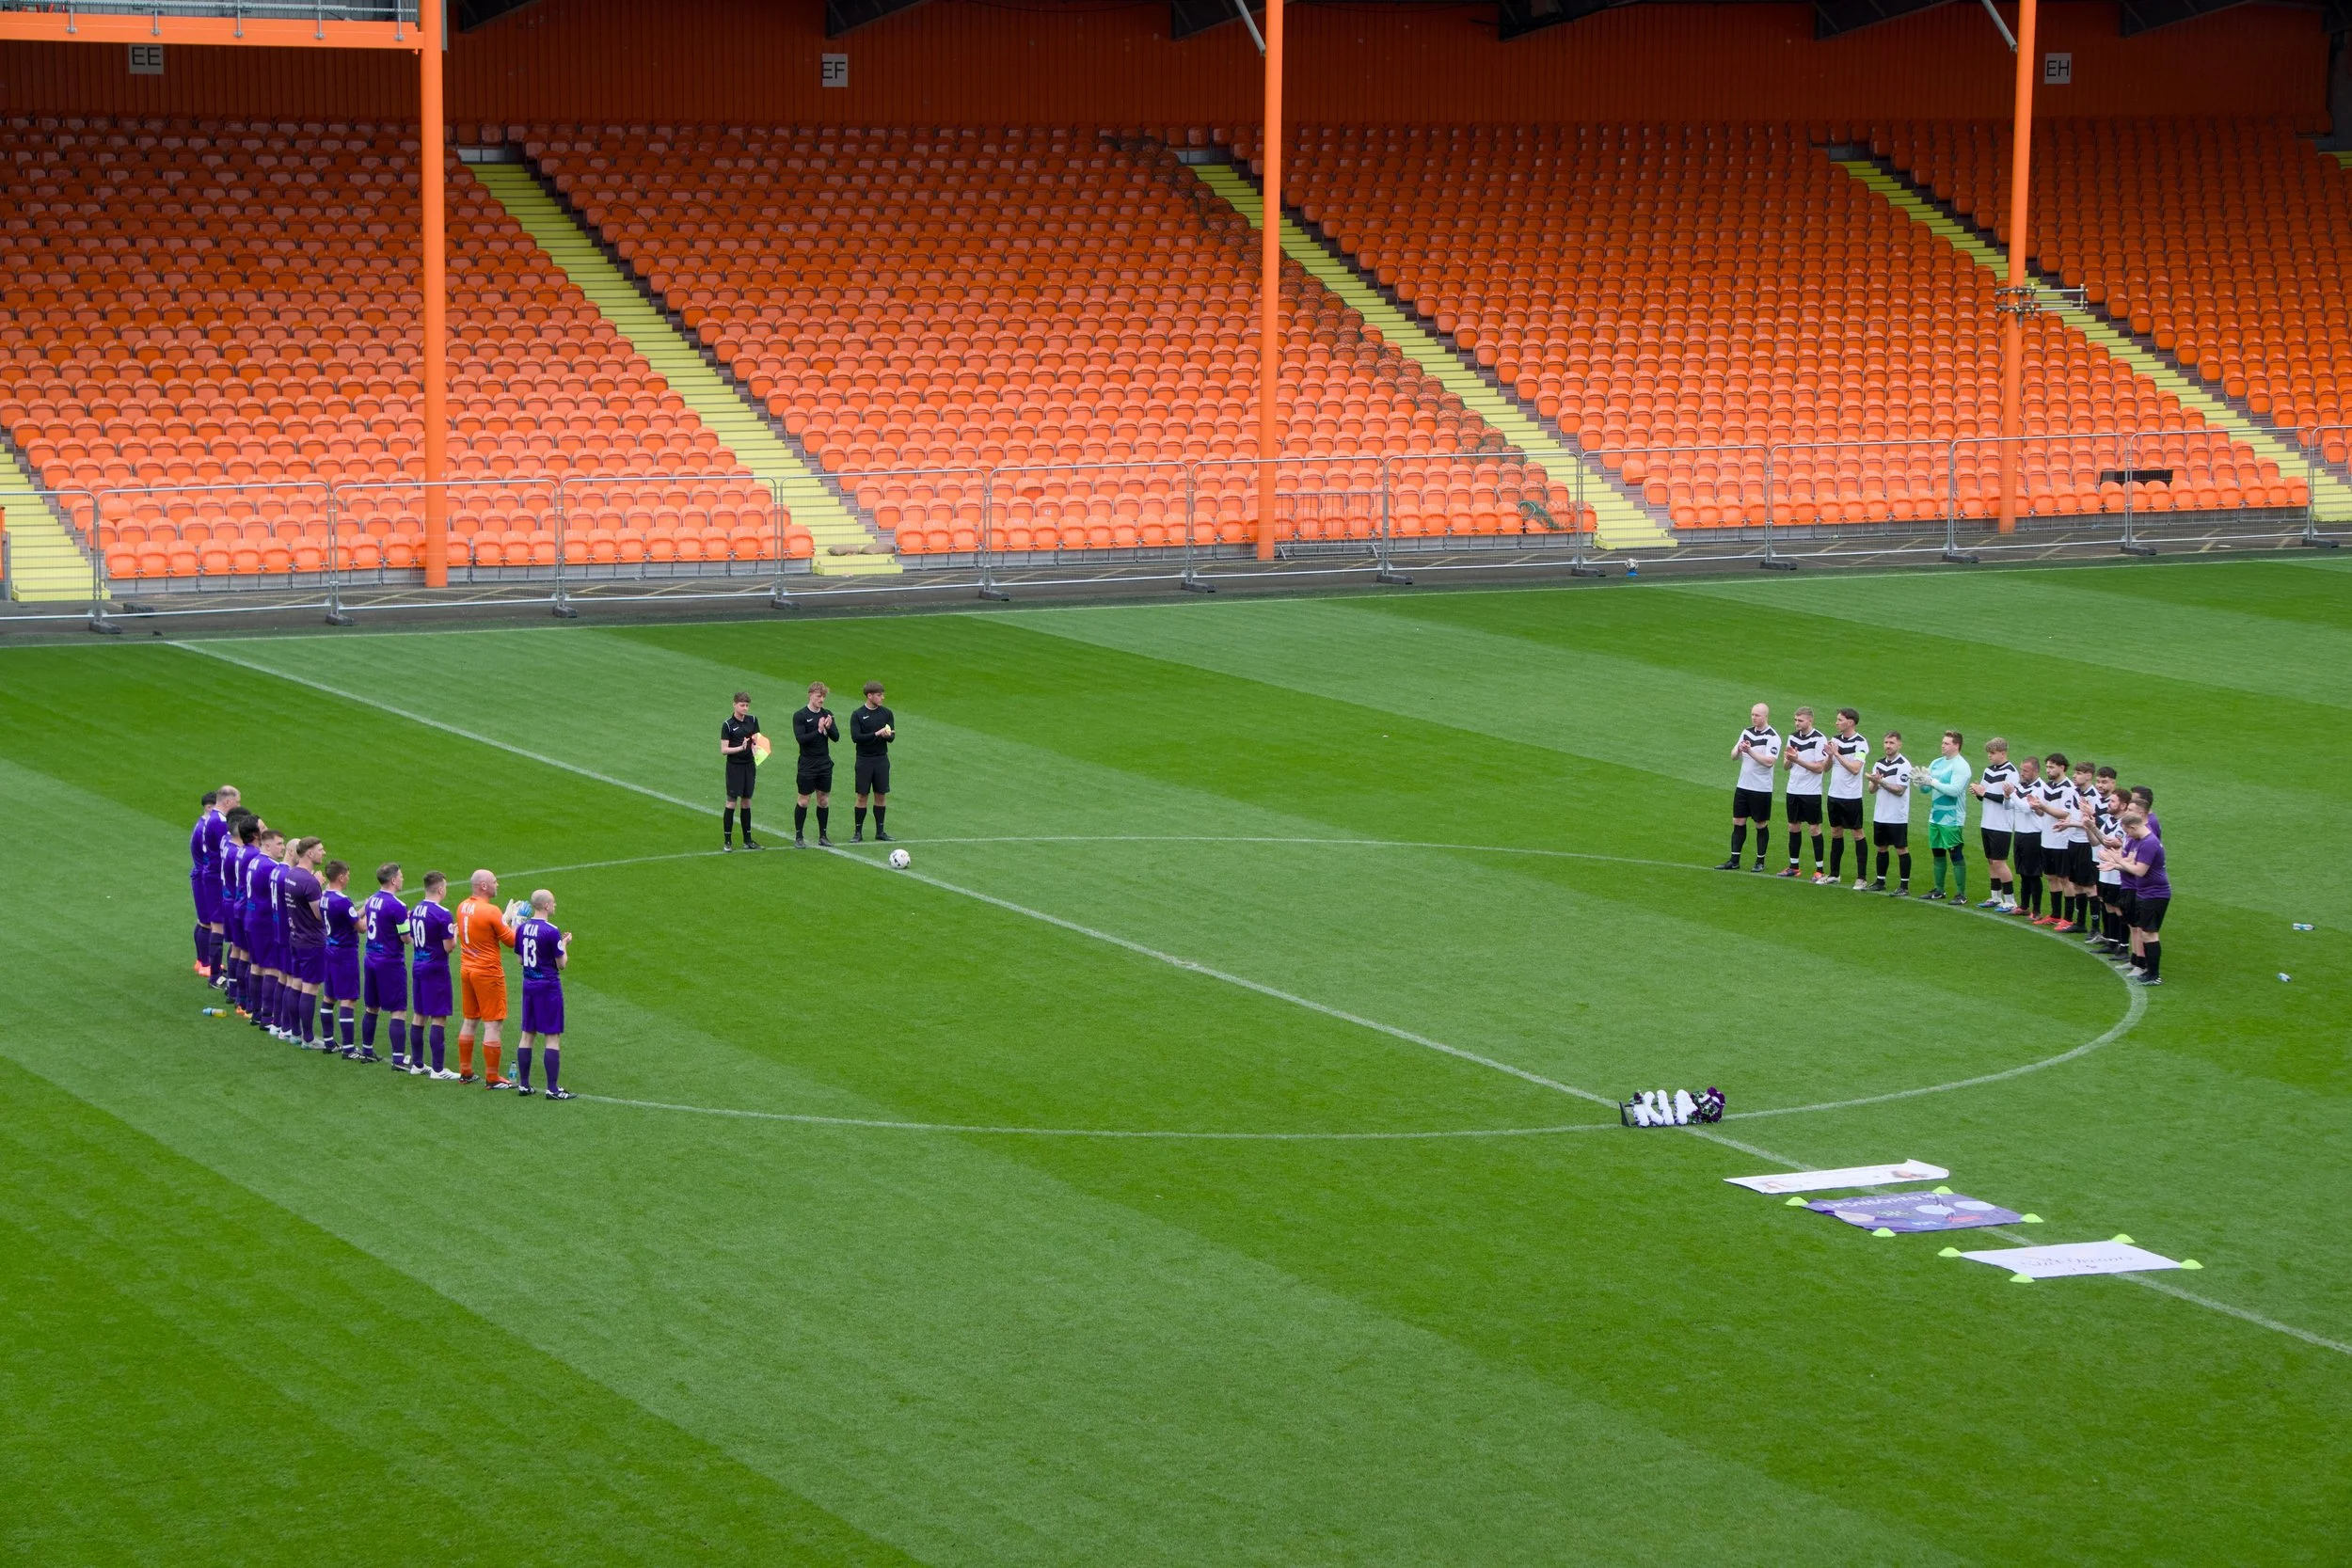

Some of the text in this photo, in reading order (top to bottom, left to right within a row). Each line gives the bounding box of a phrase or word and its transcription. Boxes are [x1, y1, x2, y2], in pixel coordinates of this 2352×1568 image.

[132, 46, 161, 66] EE
[2046, 59, 2070, 76] EH
[821, 61, 846, 79] EF
[246, 870, 252, 898] 8
[270, 881, 278, 911] 14
[369, 896, 383, 911] KIA
[413, 905, 428, 918] KIA
[461, 902, 475, 915] KIA
[368, 911, 376, 940] 5
[412, 919, 425, 947] 10
[464, 915, 469, 944] 1
[523, 923, 539, 937] KIA
[523, 938, 537, 967] 13
[1632, 1089, 1698, 1127] KIA
